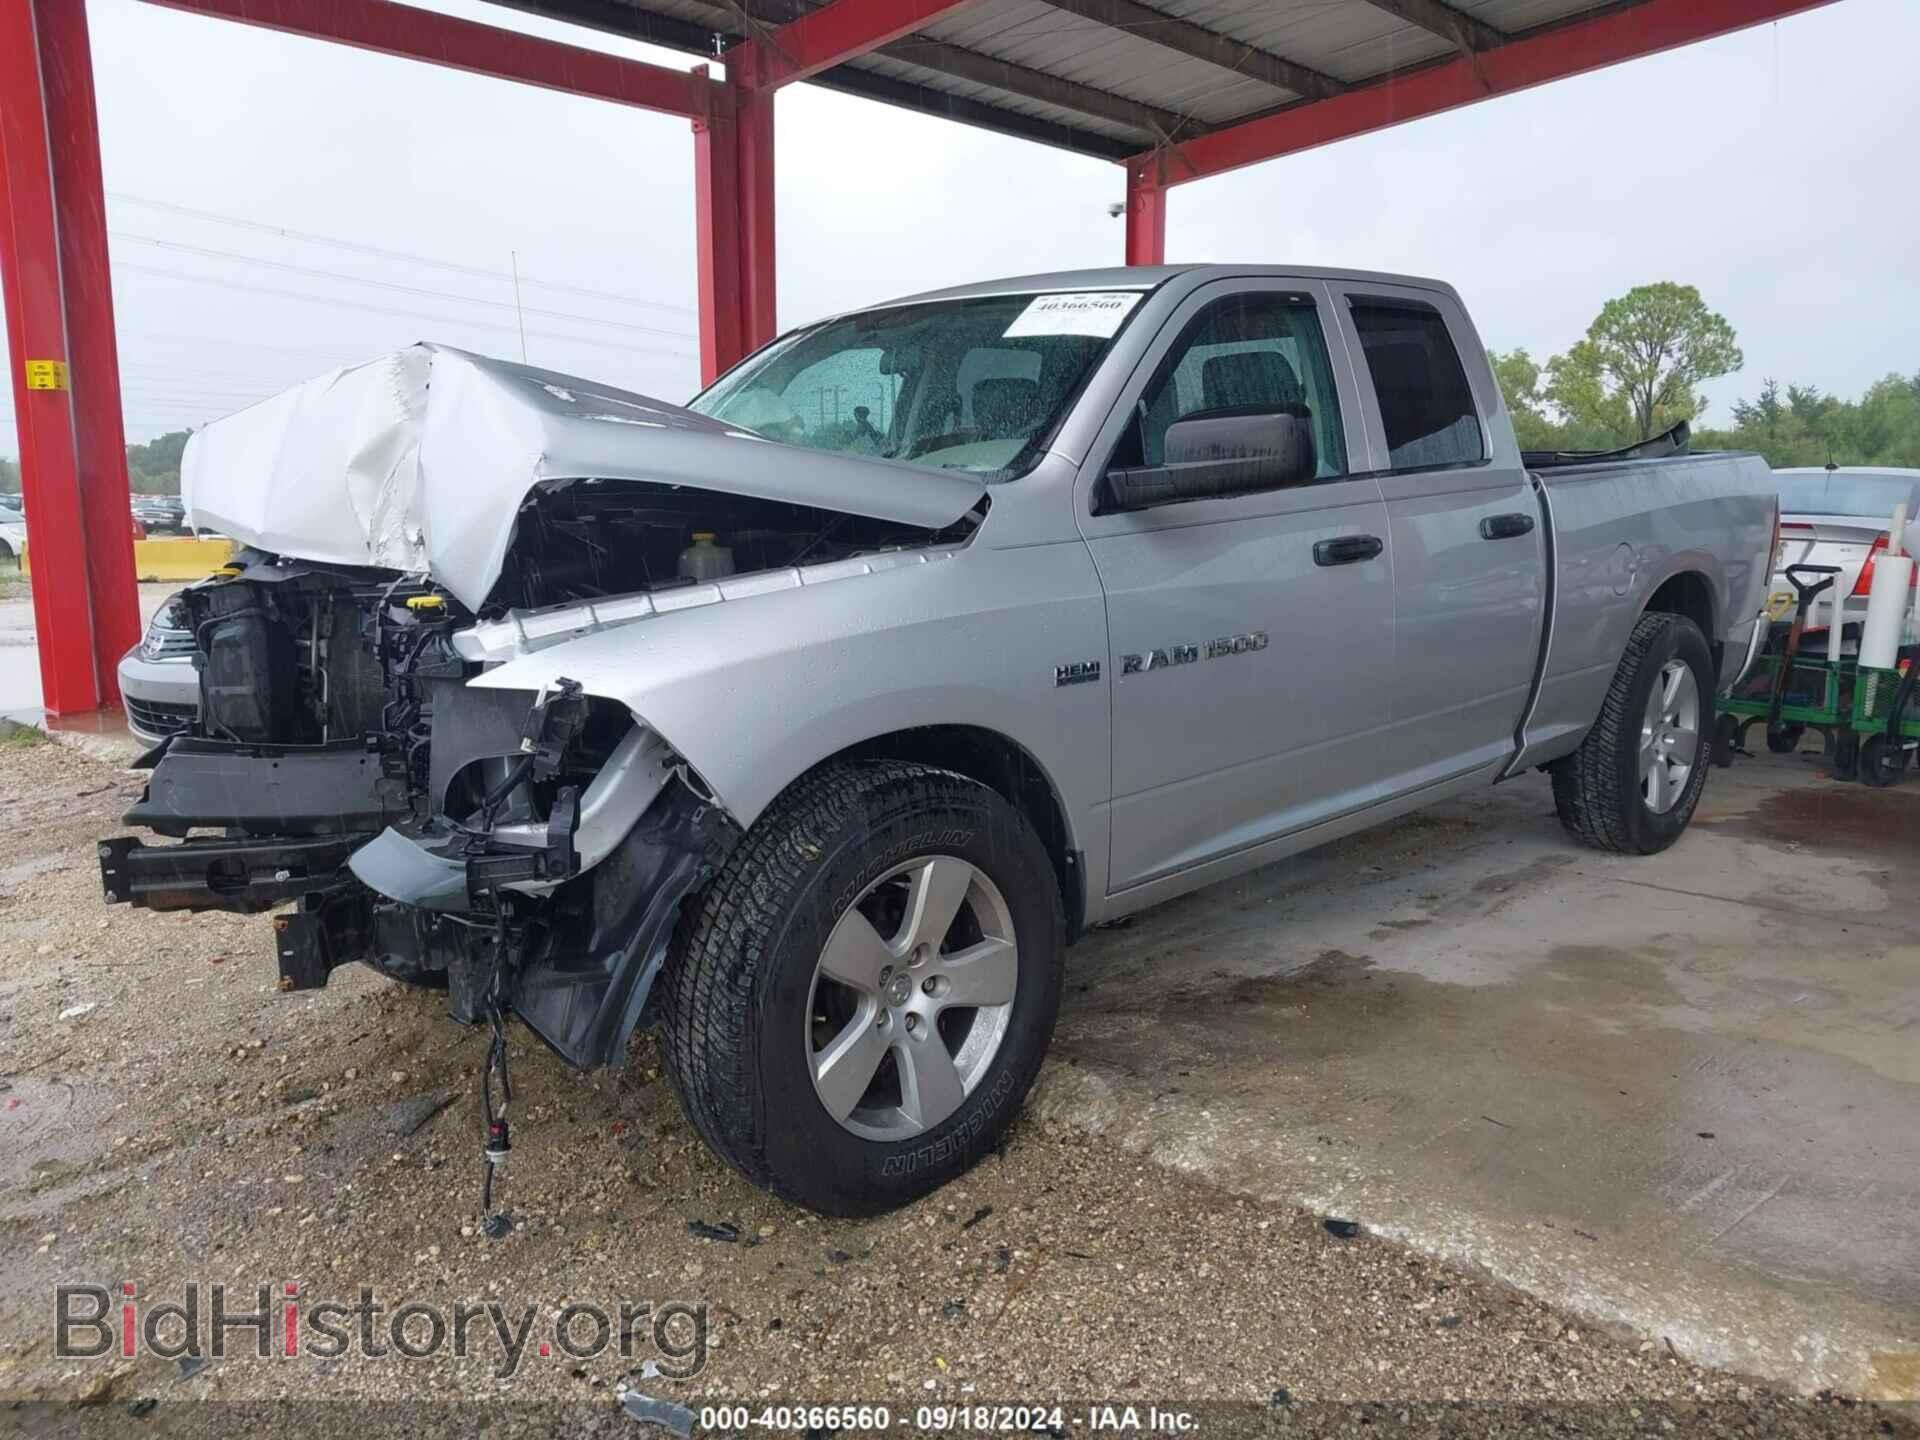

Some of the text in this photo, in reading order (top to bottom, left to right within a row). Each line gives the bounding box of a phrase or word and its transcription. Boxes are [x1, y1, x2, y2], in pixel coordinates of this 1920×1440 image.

[1054, 661, 1100, 678] HEMI
[1119, 631, 1270, 677] RAM 1500
